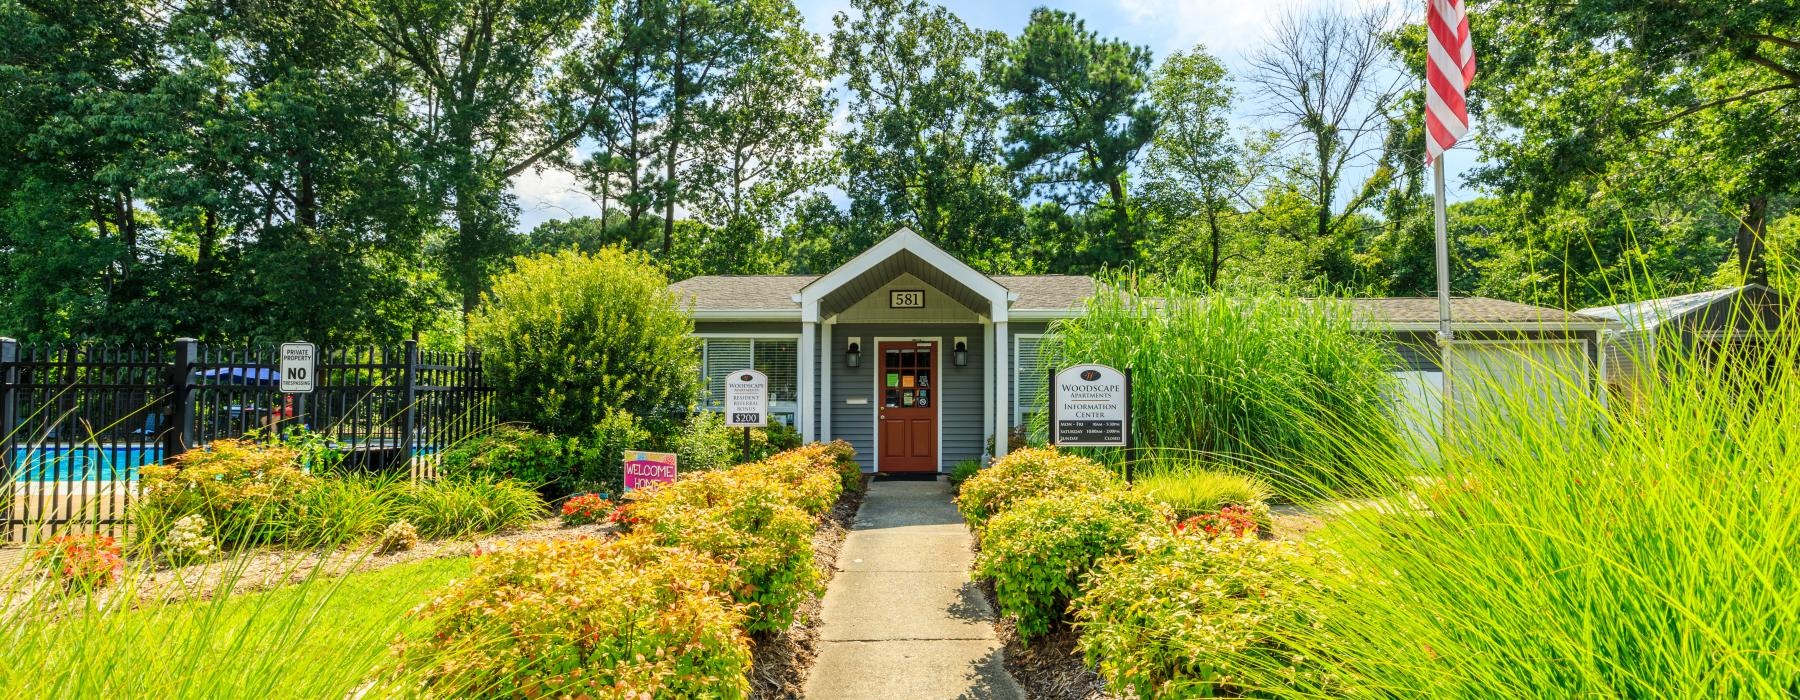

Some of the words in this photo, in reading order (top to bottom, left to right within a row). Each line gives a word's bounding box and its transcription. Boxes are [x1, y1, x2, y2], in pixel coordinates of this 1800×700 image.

[896, 294, 919, 305] 581
[288, 368, 306, 379] NO
[1062, 384, 1120, 392] WOODSCAPE
[735, 413, 757, 423] $200
[626, 463, 674, 477] WELCOME
